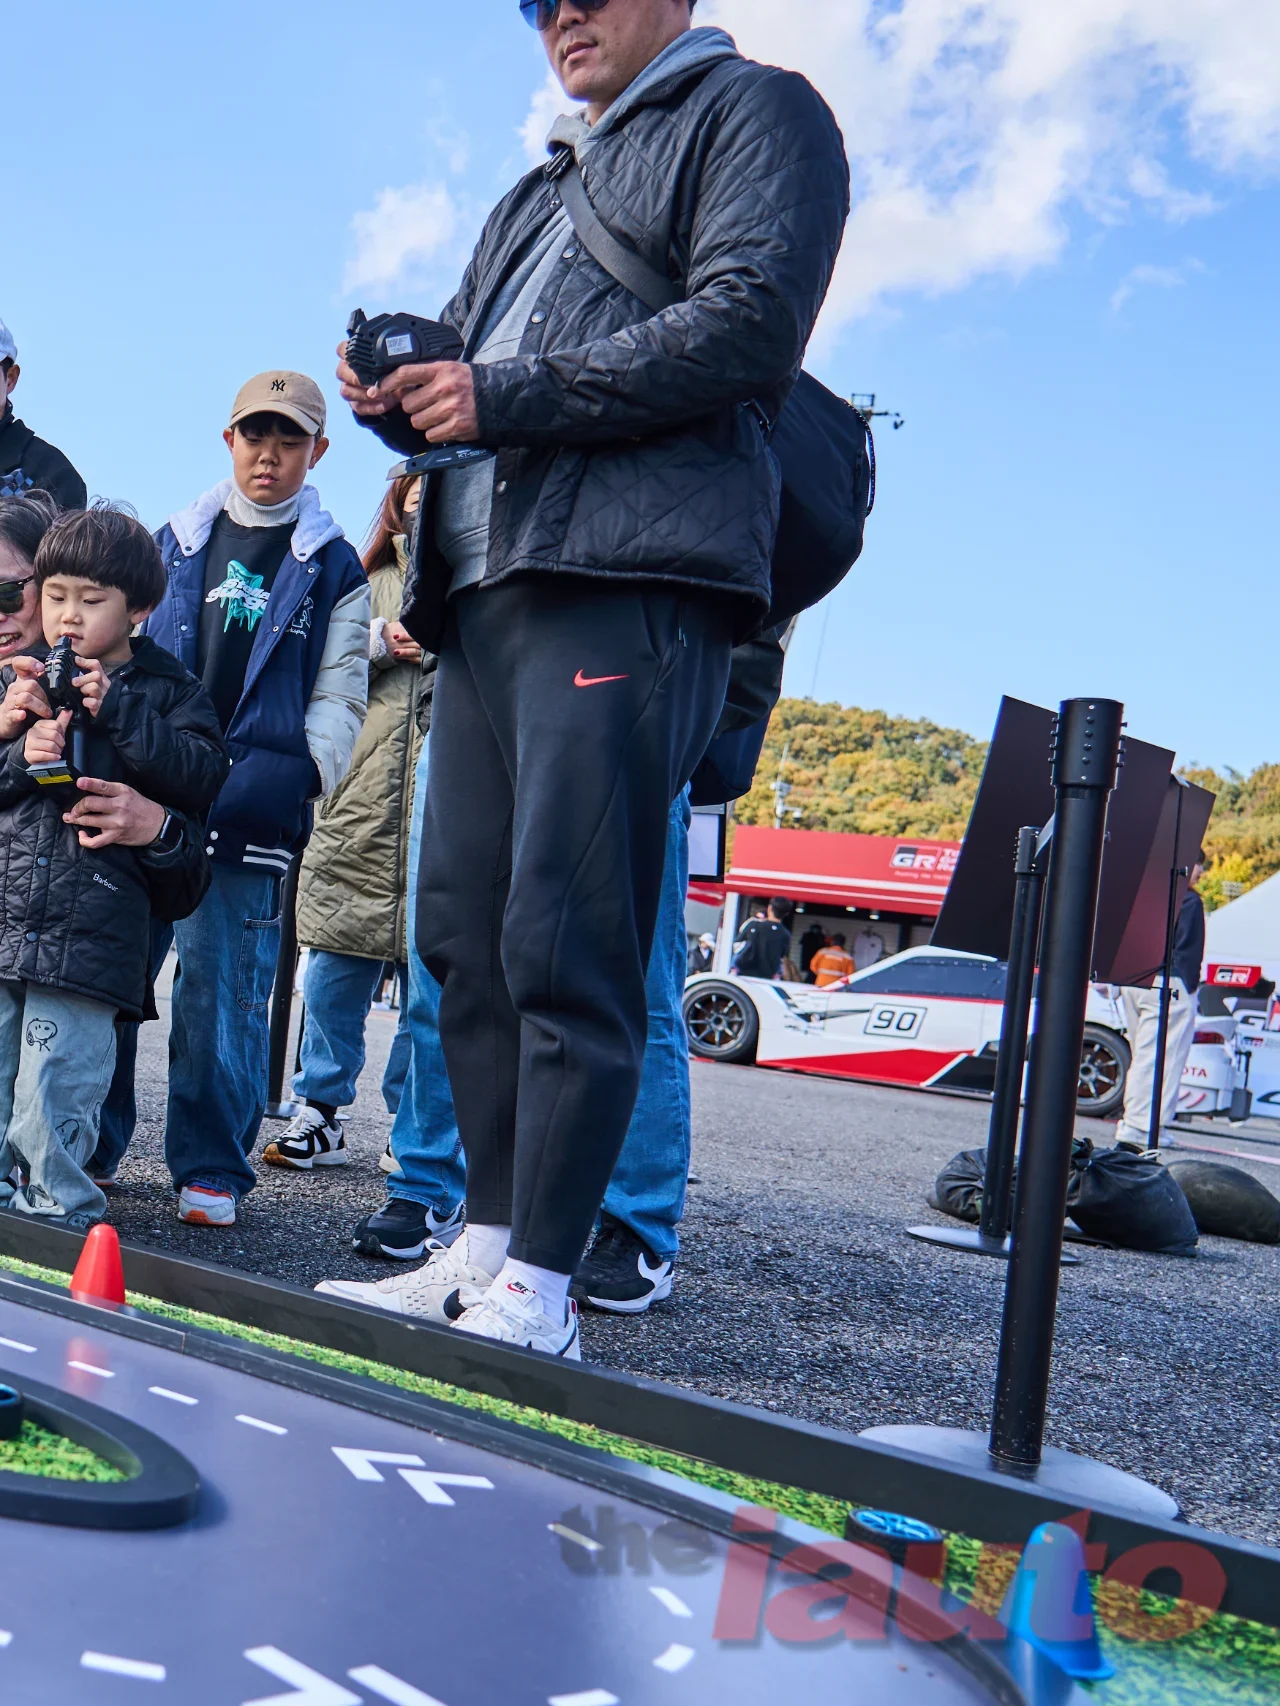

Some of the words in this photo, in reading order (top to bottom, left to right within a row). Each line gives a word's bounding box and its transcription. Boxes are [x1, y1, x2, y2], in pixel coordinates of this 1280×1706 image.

[270, 379, 286, 392] NY
[892, 853, 937, 870] GR
[92, 873, 119, 892] Barbour
[1215, 972, 1249, 985] GR
[872, 1009, 918, 1031] 90
